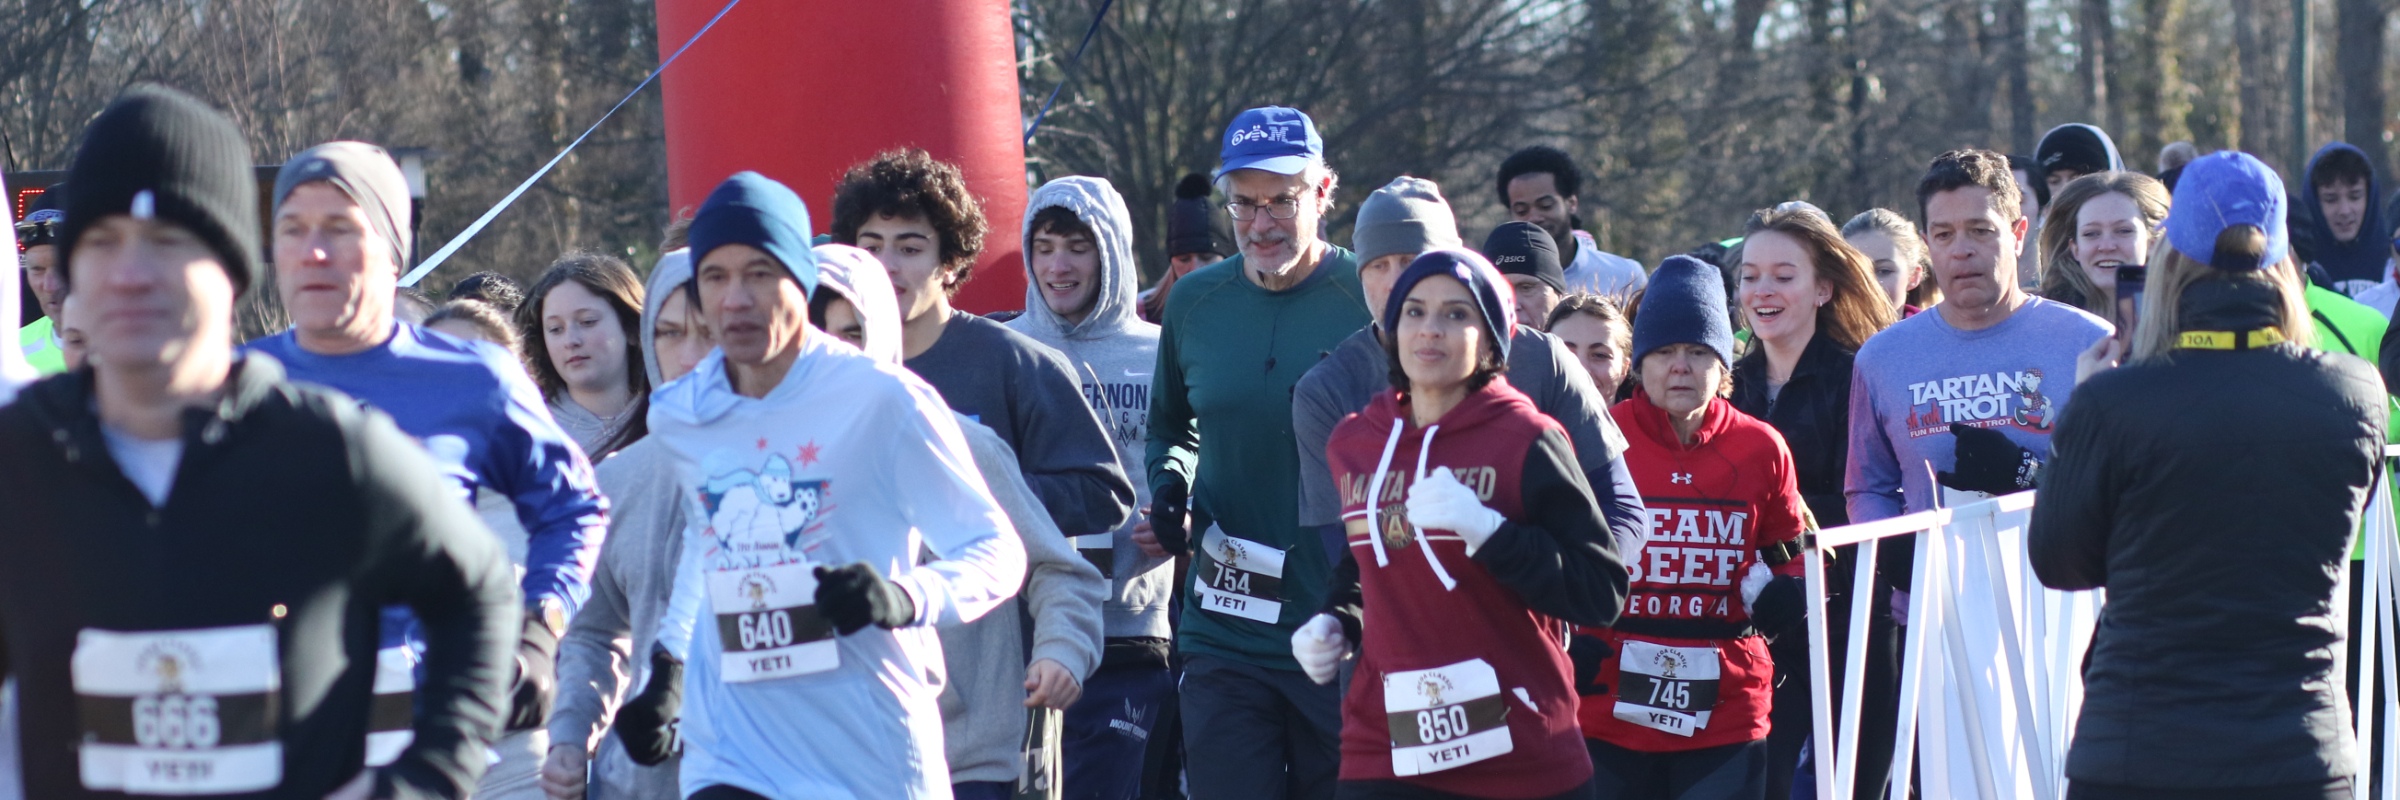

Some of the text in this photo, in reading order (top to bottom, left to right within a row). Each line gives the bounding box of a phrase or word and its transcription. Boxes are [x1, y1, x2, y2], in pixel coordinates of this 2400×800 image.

[1504, 255, 1526, 263] asics
[1082, 383, 1148, 411] ERNON
[1908, 371, 2023, 406] TARTAN
[1939, 393, 2012, 423] TROT
[1910, 429, 1928, 438] FUN
[1929, 425, 1950, 434] RUN
[1985, 418, 2012, 427] TROT
[1645, 508, 1748, 545] EAM
[1213, 562, 1251, 595] 754
[1214, 594, 1247, 611] YETI
[1628, 594, 1728, 617] EORGA
[737, 610, 794, 651] 640
[748, 655, 792, 673] YETI
[1653, 648, 1688, 669] COCOA CLASSIC
[1648, 677, 1690, 709] 745
[132, 695, 221, 748] 666
[1417, 704, 1469, 744] 850
[1648, 712, 1683, 729] YETI
[1428, 744, 1471, 764] YETI
